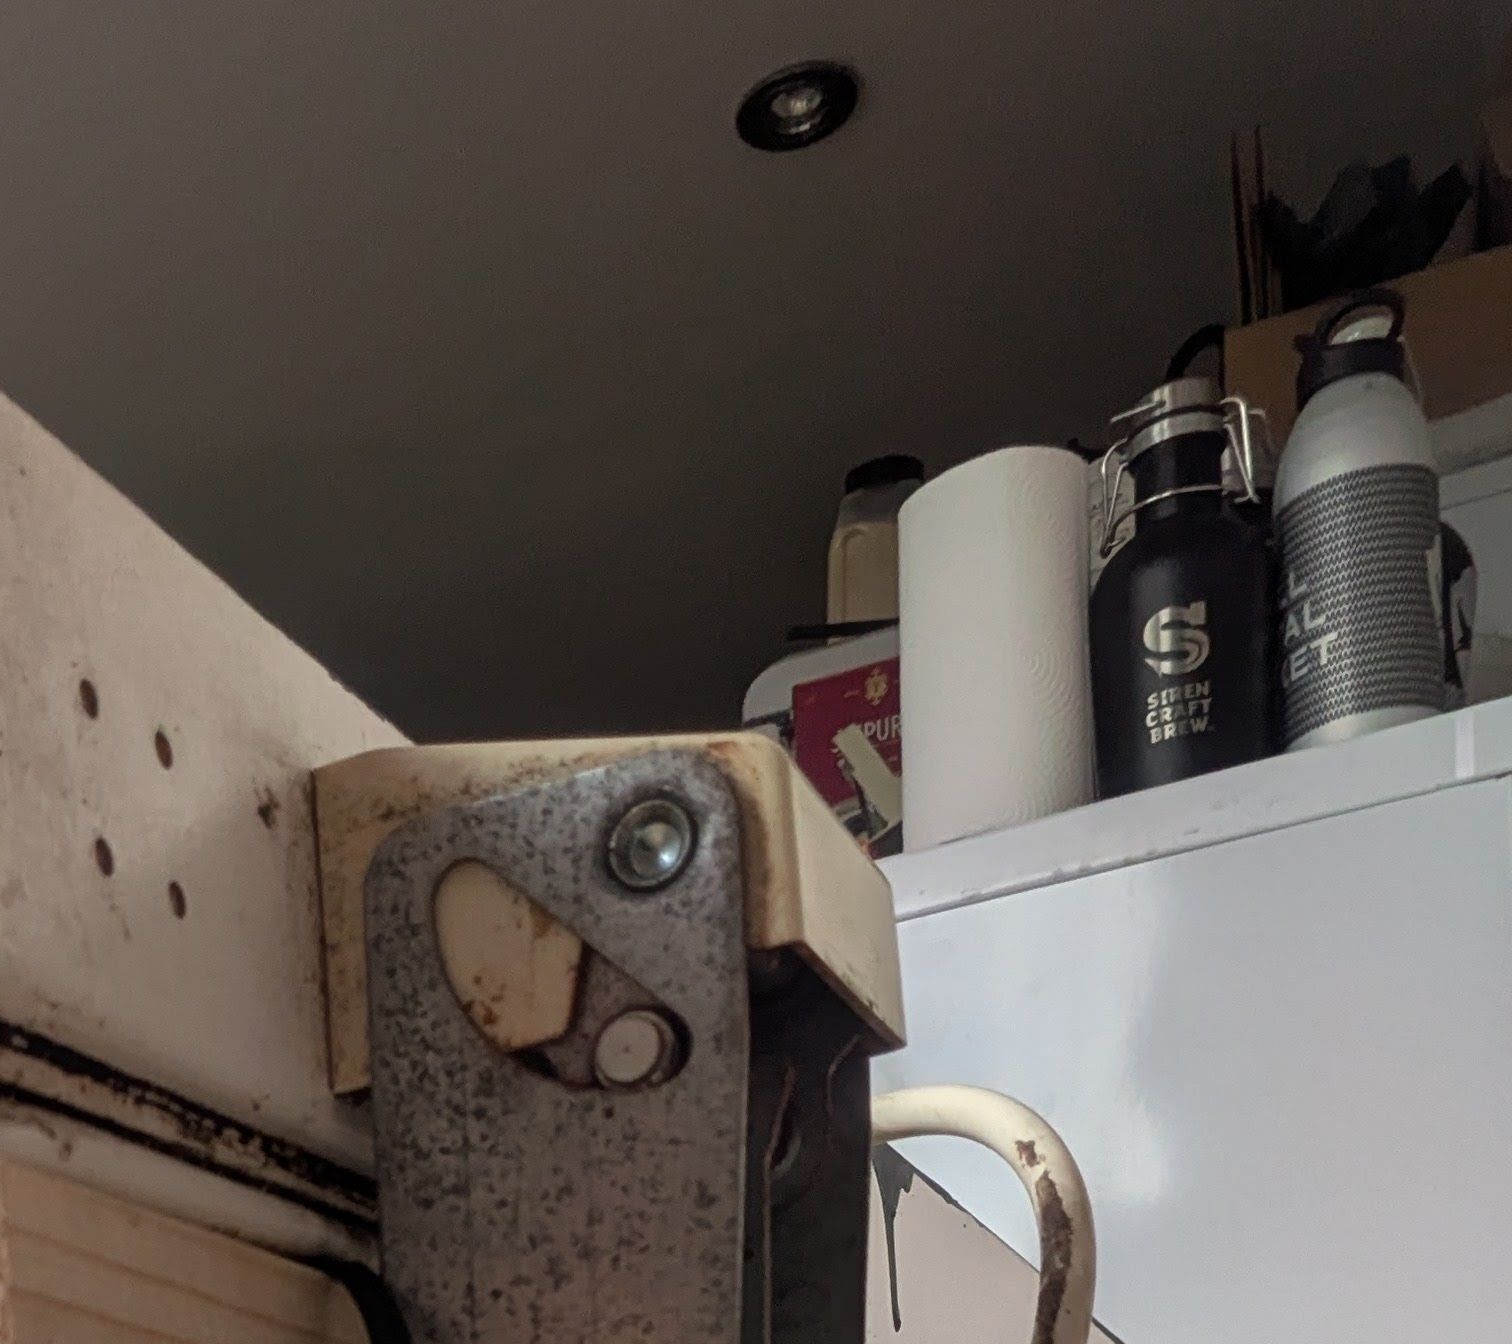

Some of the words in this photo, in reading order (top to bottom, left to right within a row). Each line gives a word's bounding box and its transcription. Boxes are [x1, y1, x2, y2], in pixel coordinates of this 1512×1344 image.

[1147, 680, 1210, 710] SIREN
[1145, 697, 1212, 728] CRAFT
[1150, 715, 1210, 744] BREW
